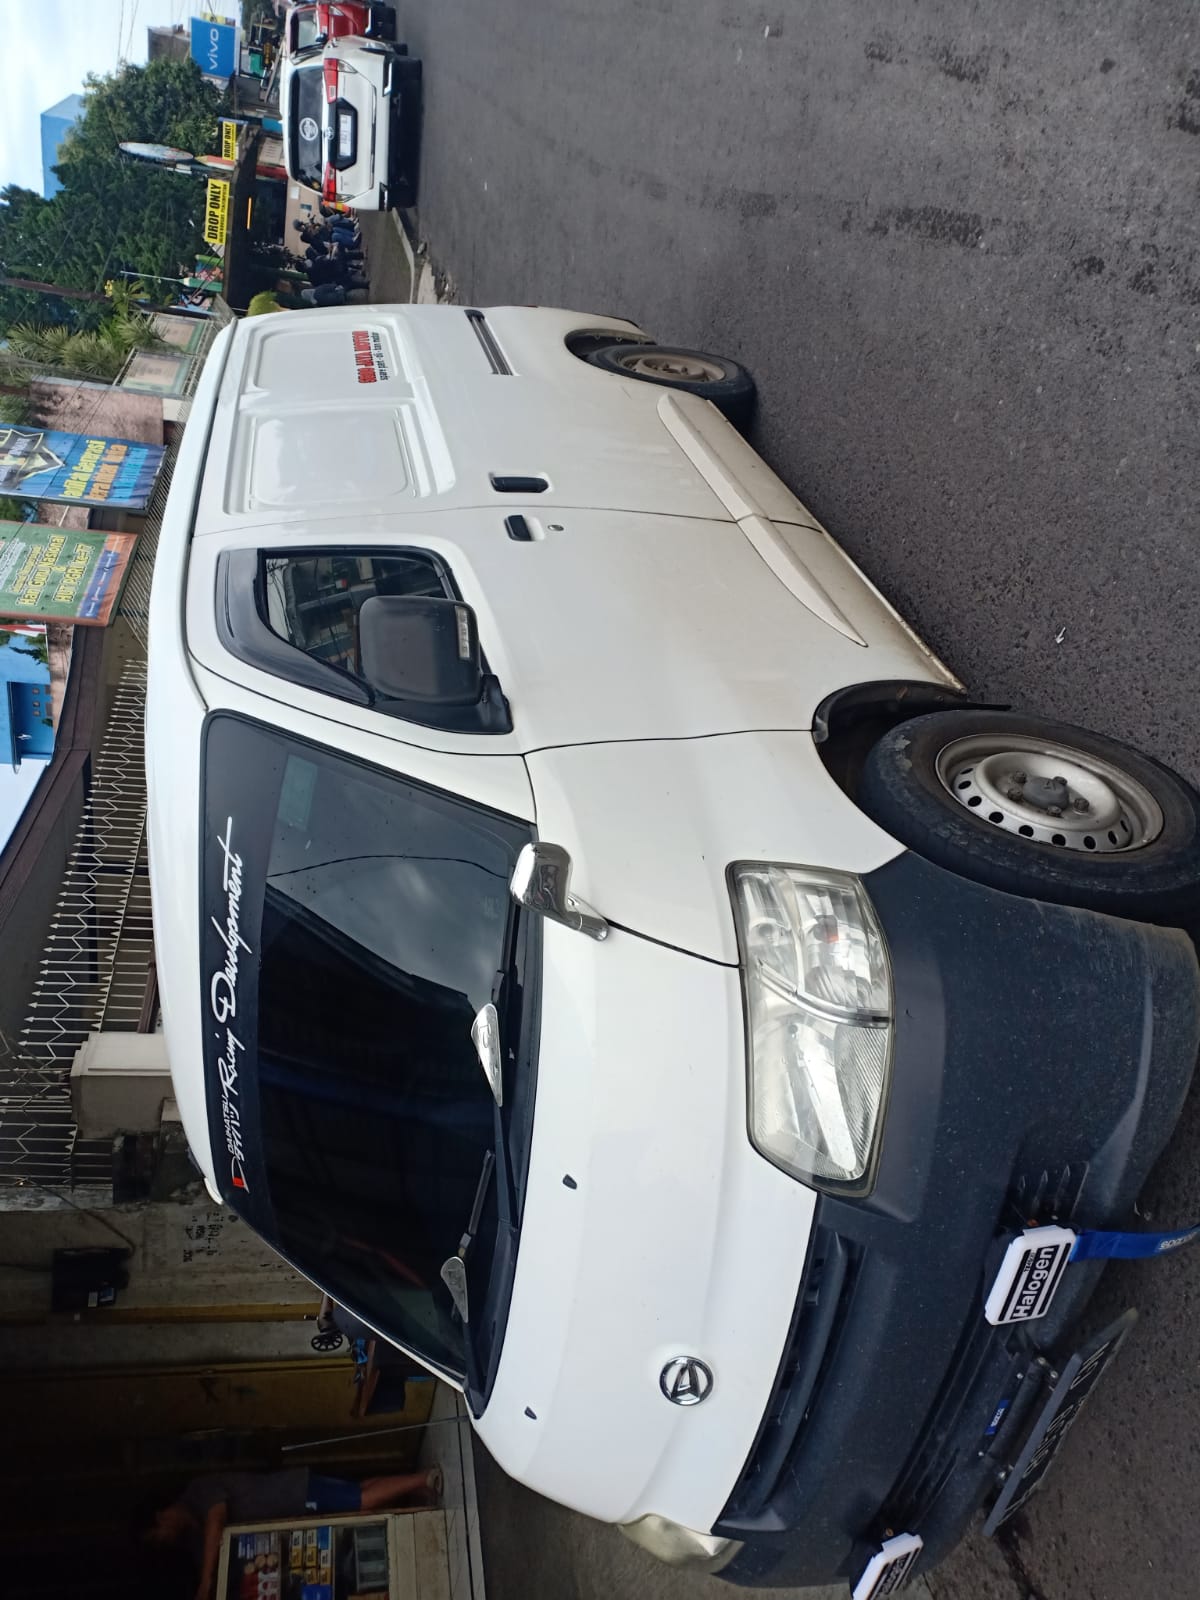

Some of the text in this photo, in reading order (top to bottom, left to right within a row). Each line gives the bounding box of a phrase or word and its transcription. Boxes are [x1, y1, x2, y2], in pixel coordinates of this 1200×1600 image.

[208, 28, 219, 70] vivo
[224, 124, 232, 140] ONLY
[207, 183, 221, 239] DROP ONLY
[352, 331, 371, 352] MOTOR
[355, 352, 374, 366] JAYA
[38, 535, 66, 567] Nasional
[28, 568, 51, 586] Guru
[63, 566, 85, 583] PGRI
[54, 585, 75, 601] HUT
[211, 816, 252, 1096] Racing Development
[222, 1095, 235, 1153] DAIHATSU
[1012, 1247, 1055, 1318] Halogen
